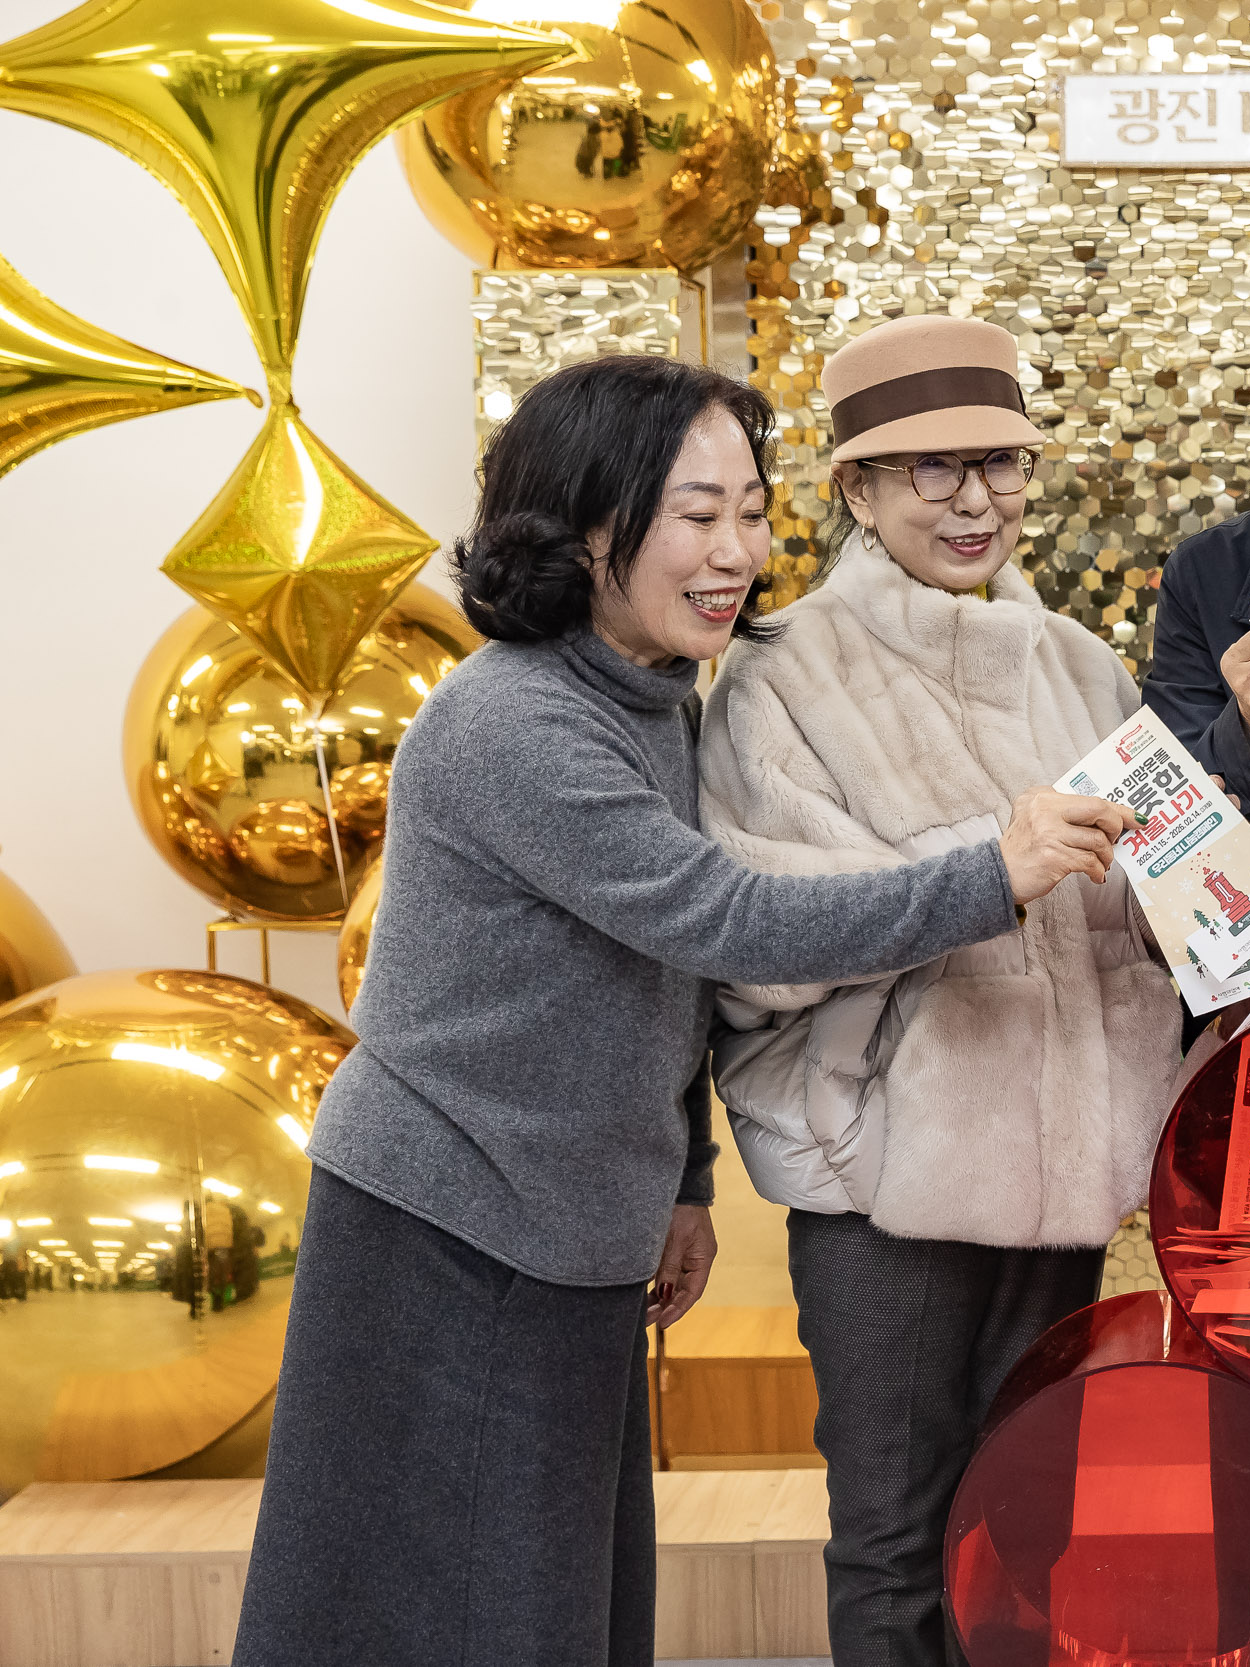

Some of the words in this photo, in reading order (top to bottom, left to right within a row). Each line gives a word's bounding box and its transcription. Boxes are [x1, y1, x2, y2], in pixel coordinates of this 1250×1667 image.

[1108, 88, 1217, 145] 광진
[1122, 748, 1171, 791] 희망온돌
[1123, 762, 1189, 816] 뜻한
[1123, 784, 1203, 856] 겨울나기
